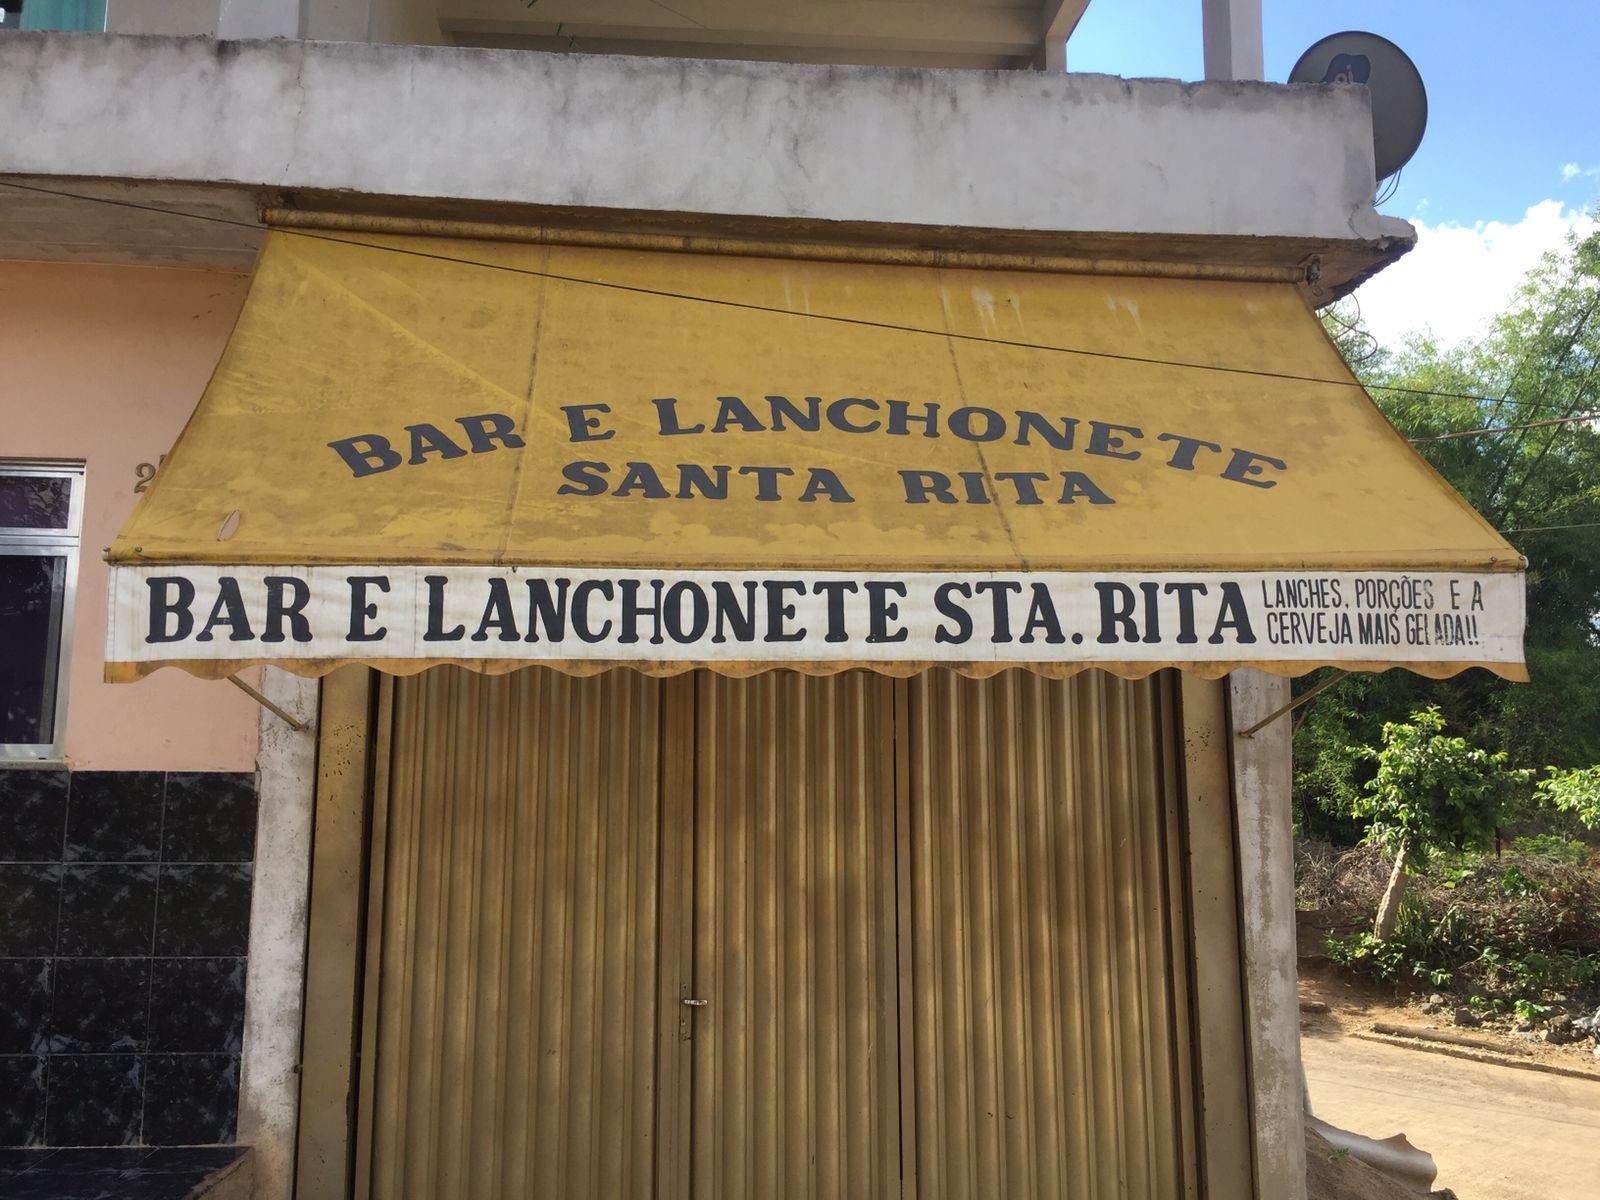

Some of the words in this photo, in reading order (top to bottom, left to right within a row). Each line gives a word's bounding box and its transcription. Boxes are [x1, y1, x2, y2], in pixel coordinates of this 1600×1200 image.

[327, 413, 527, 478] BAR
[559, 403, 616, 443] E
[651, 395, 1287, 489] LANCHONETE
[556, 460, 856, 503] SANTA
[897, 470, 1116, 506] RITA
[144, 575, 314, 644] BAR
[345, 575, 391, 643] E
[422, 575, 909, 644] LANCHONETE
[1093, 581, 1257, 645] RITA
[1261, 578, 1350, 610] LANCHES,
[1354, 575, 1435, 613] PORÇÕES
[1266, 611, 1354, 645] CERVEJA
[1357, 612, 1401, 646] MAIS
